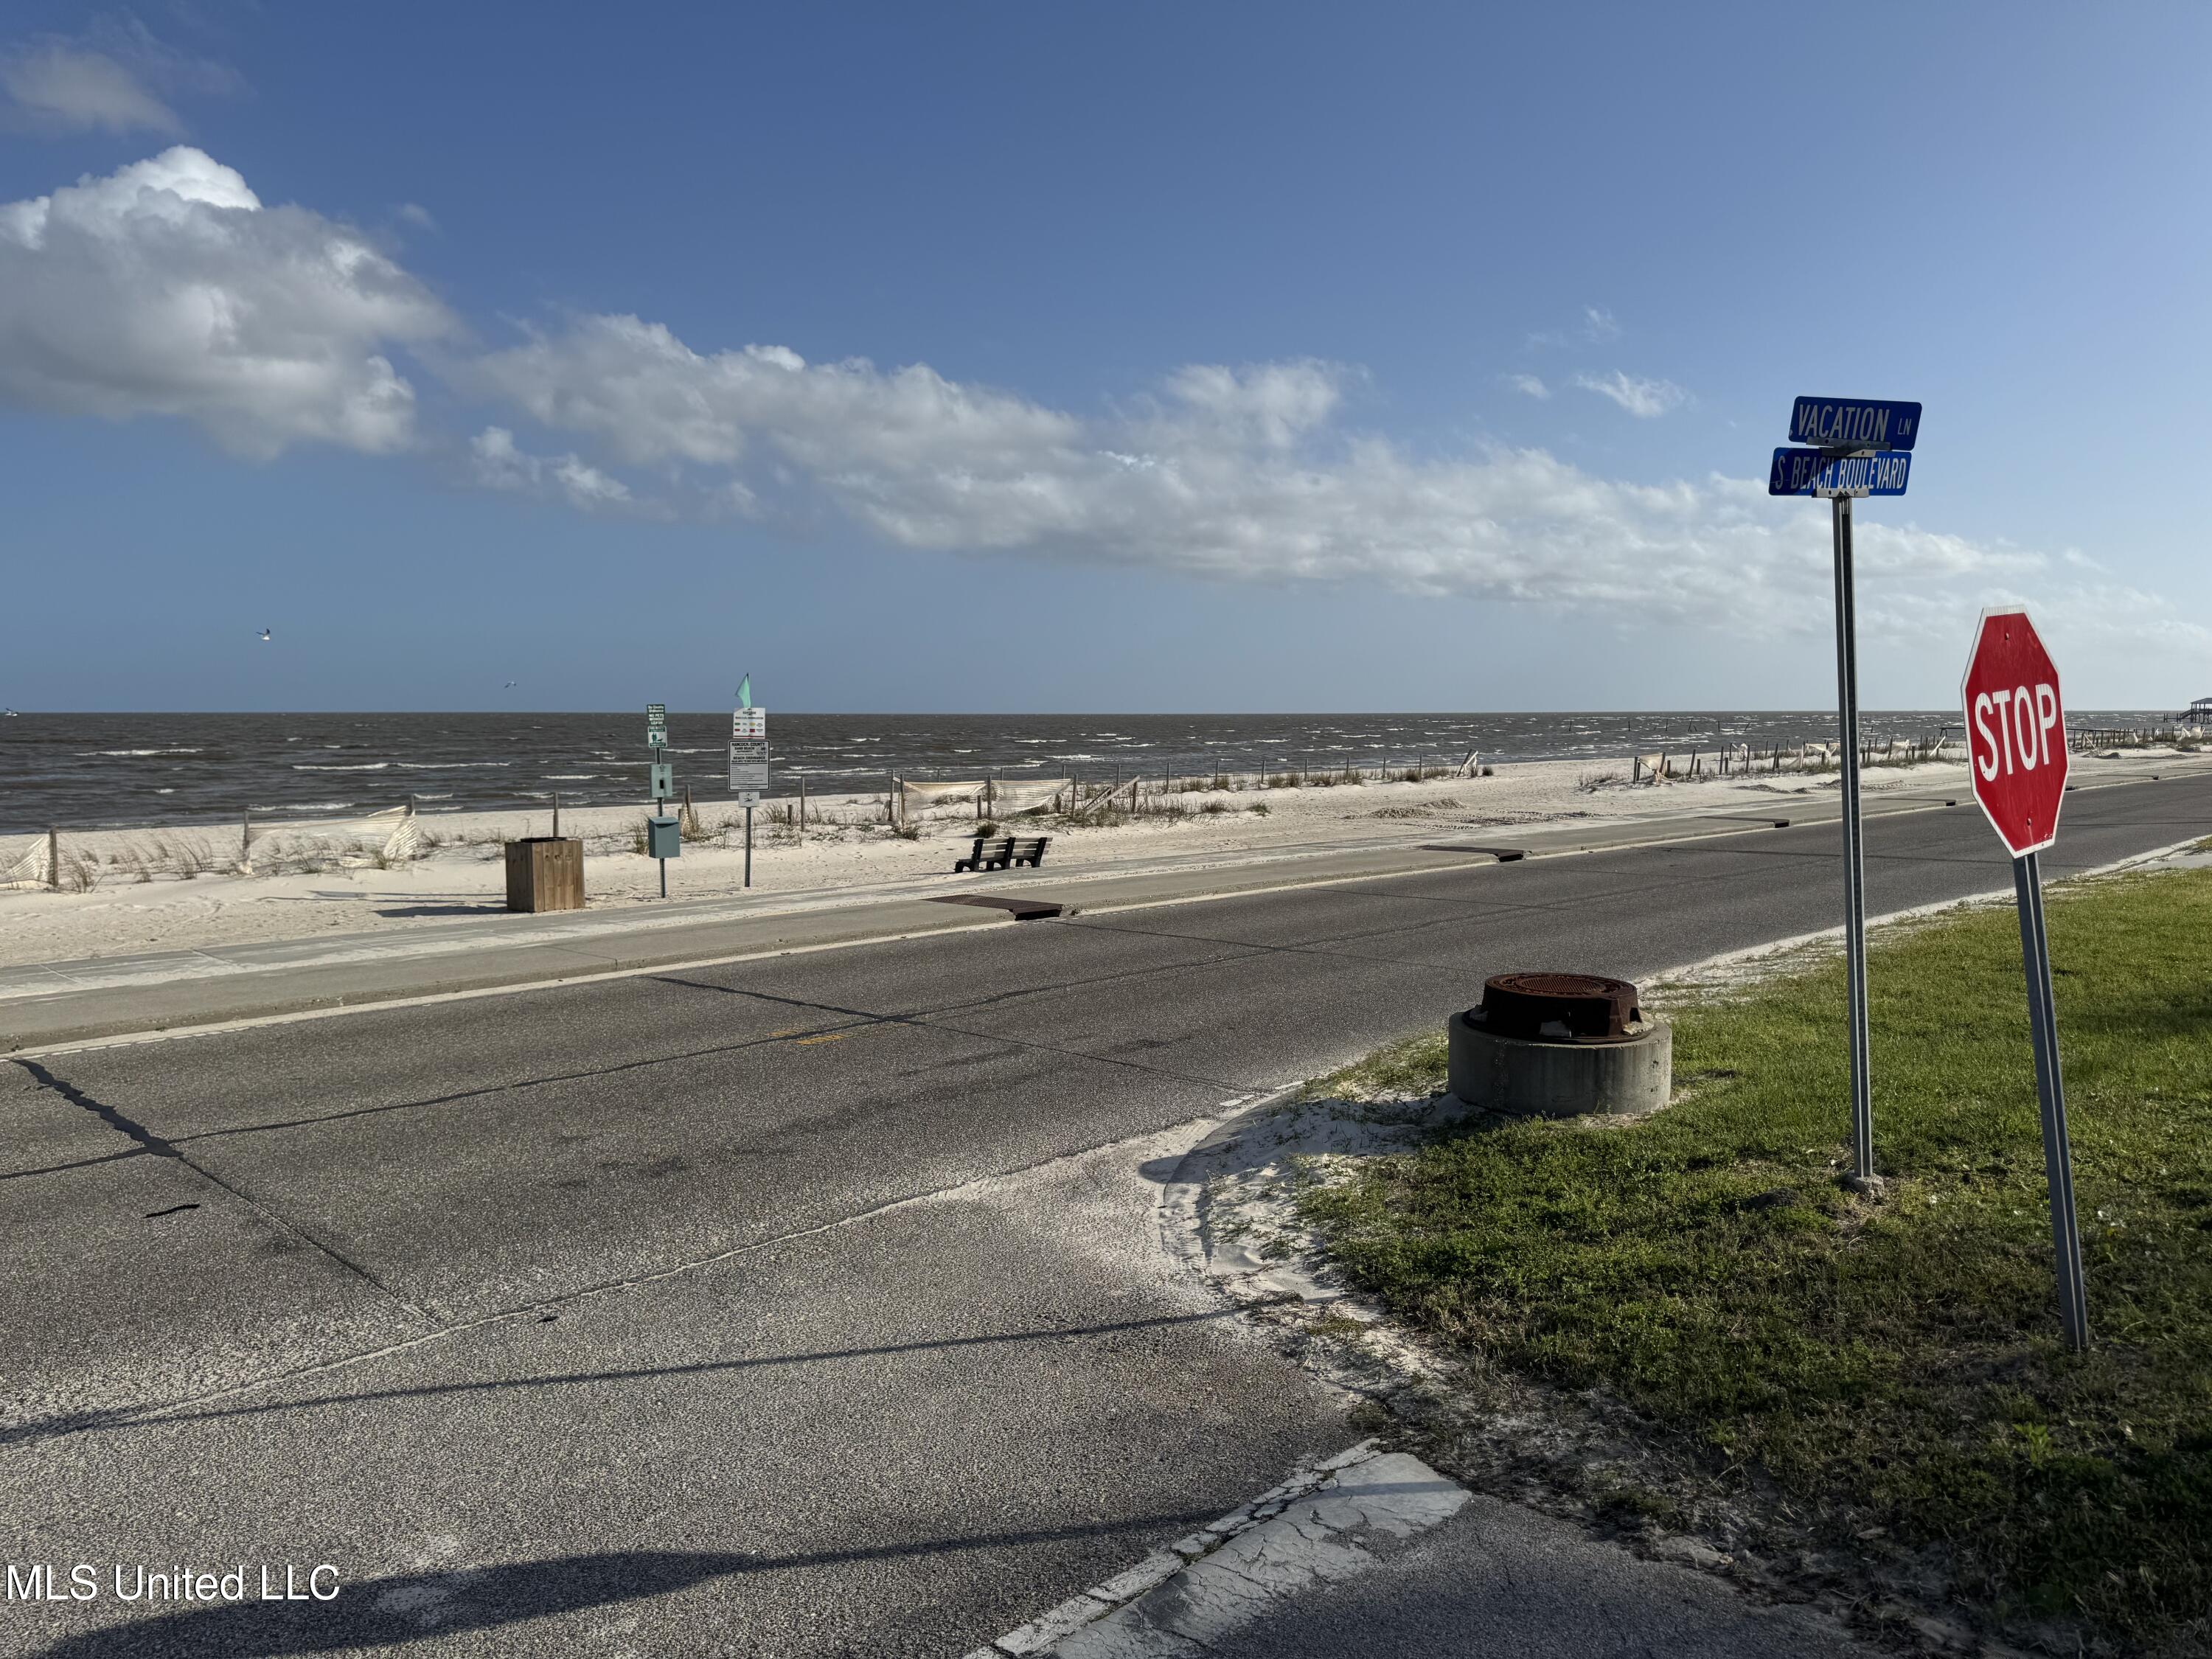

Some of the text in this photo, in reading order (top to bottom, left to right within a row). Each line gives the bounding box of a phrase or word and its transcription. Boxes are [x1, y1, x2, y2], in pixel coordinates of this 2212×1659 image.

[1798, 404, 1912, 442] VACATION LN
[1775, 456, 1907, 490] S BEACH BOULEVARD
[1975, 683, 2056, 782] STOP
